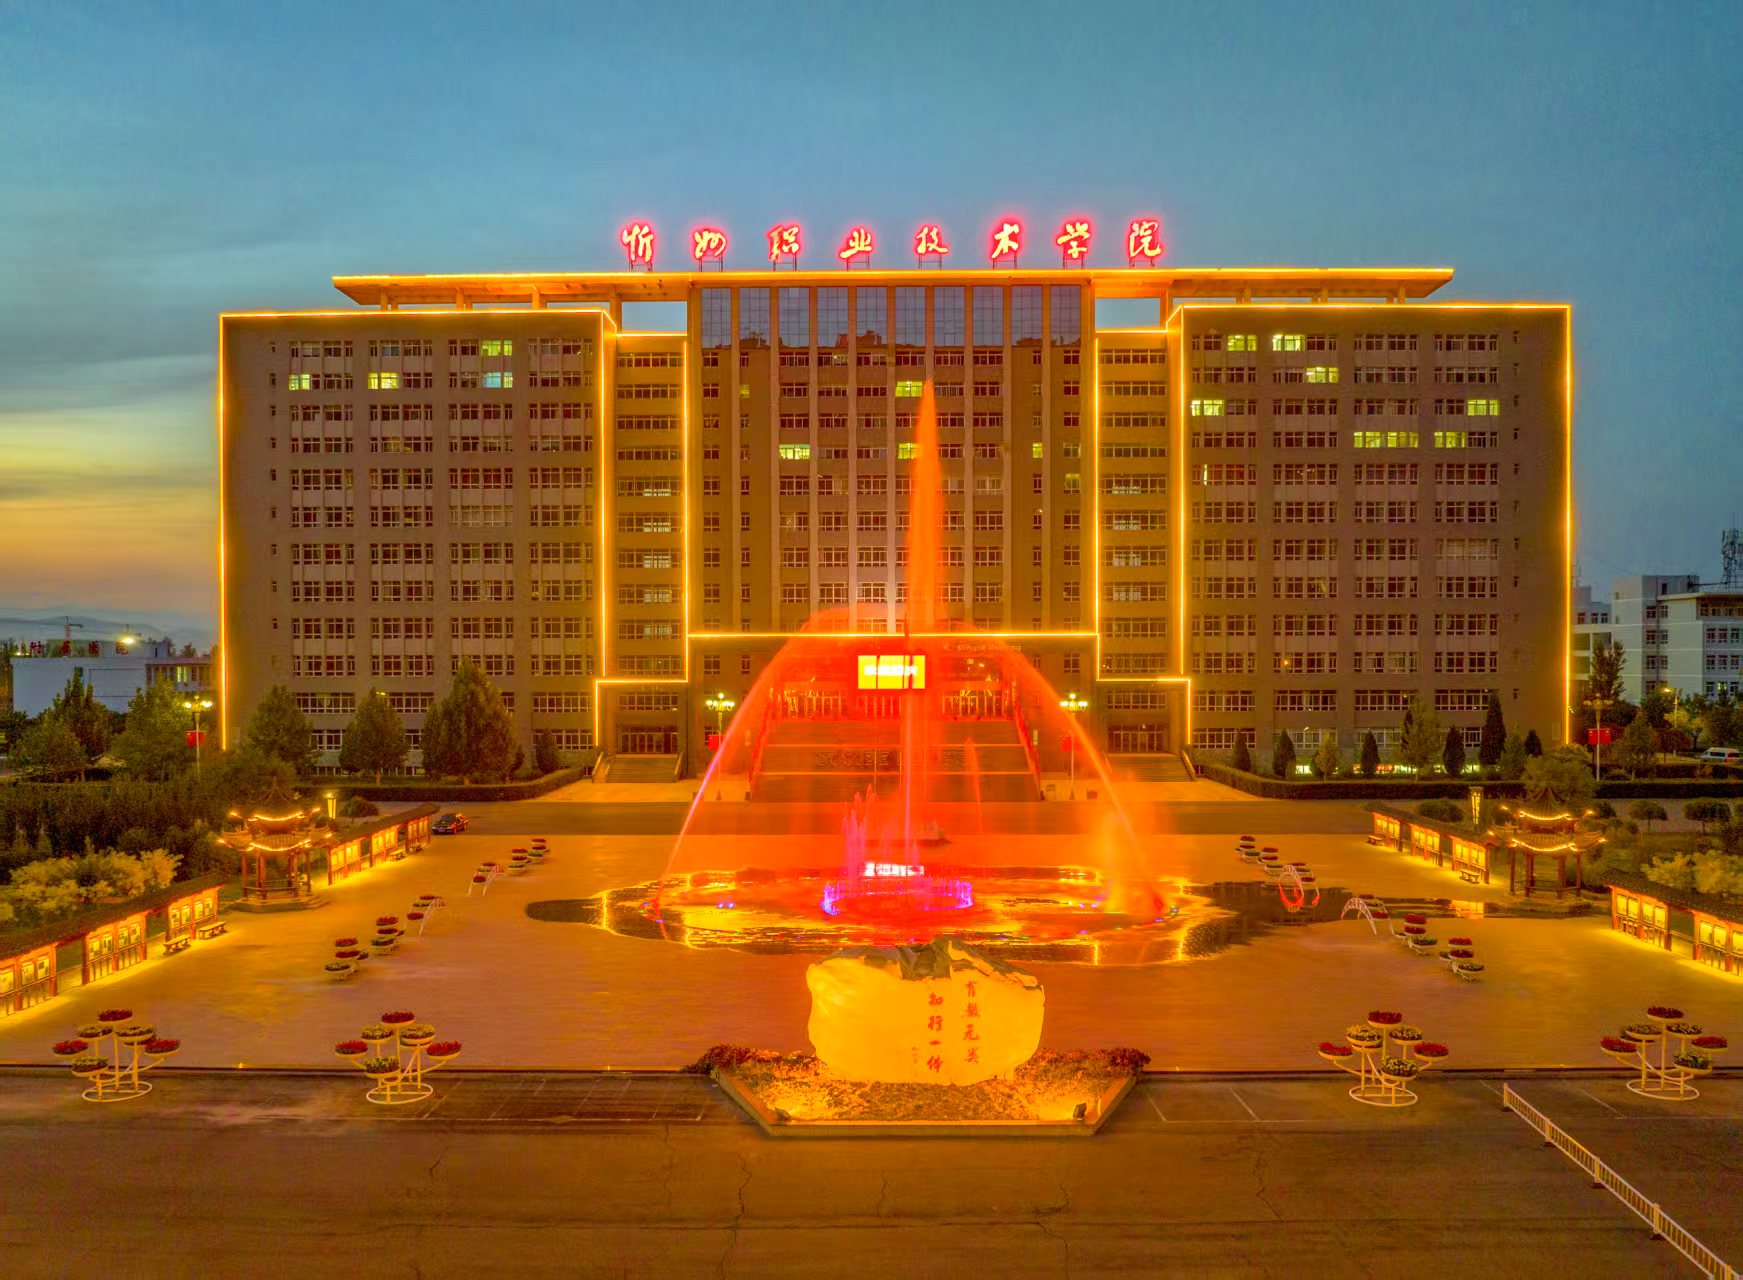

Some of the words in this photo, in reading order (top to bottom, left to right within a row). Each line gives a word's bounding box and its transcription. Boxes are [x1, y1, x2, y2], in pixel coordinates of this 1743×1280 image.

[621, 222, 1162, 262] 忻州职业技术学院
